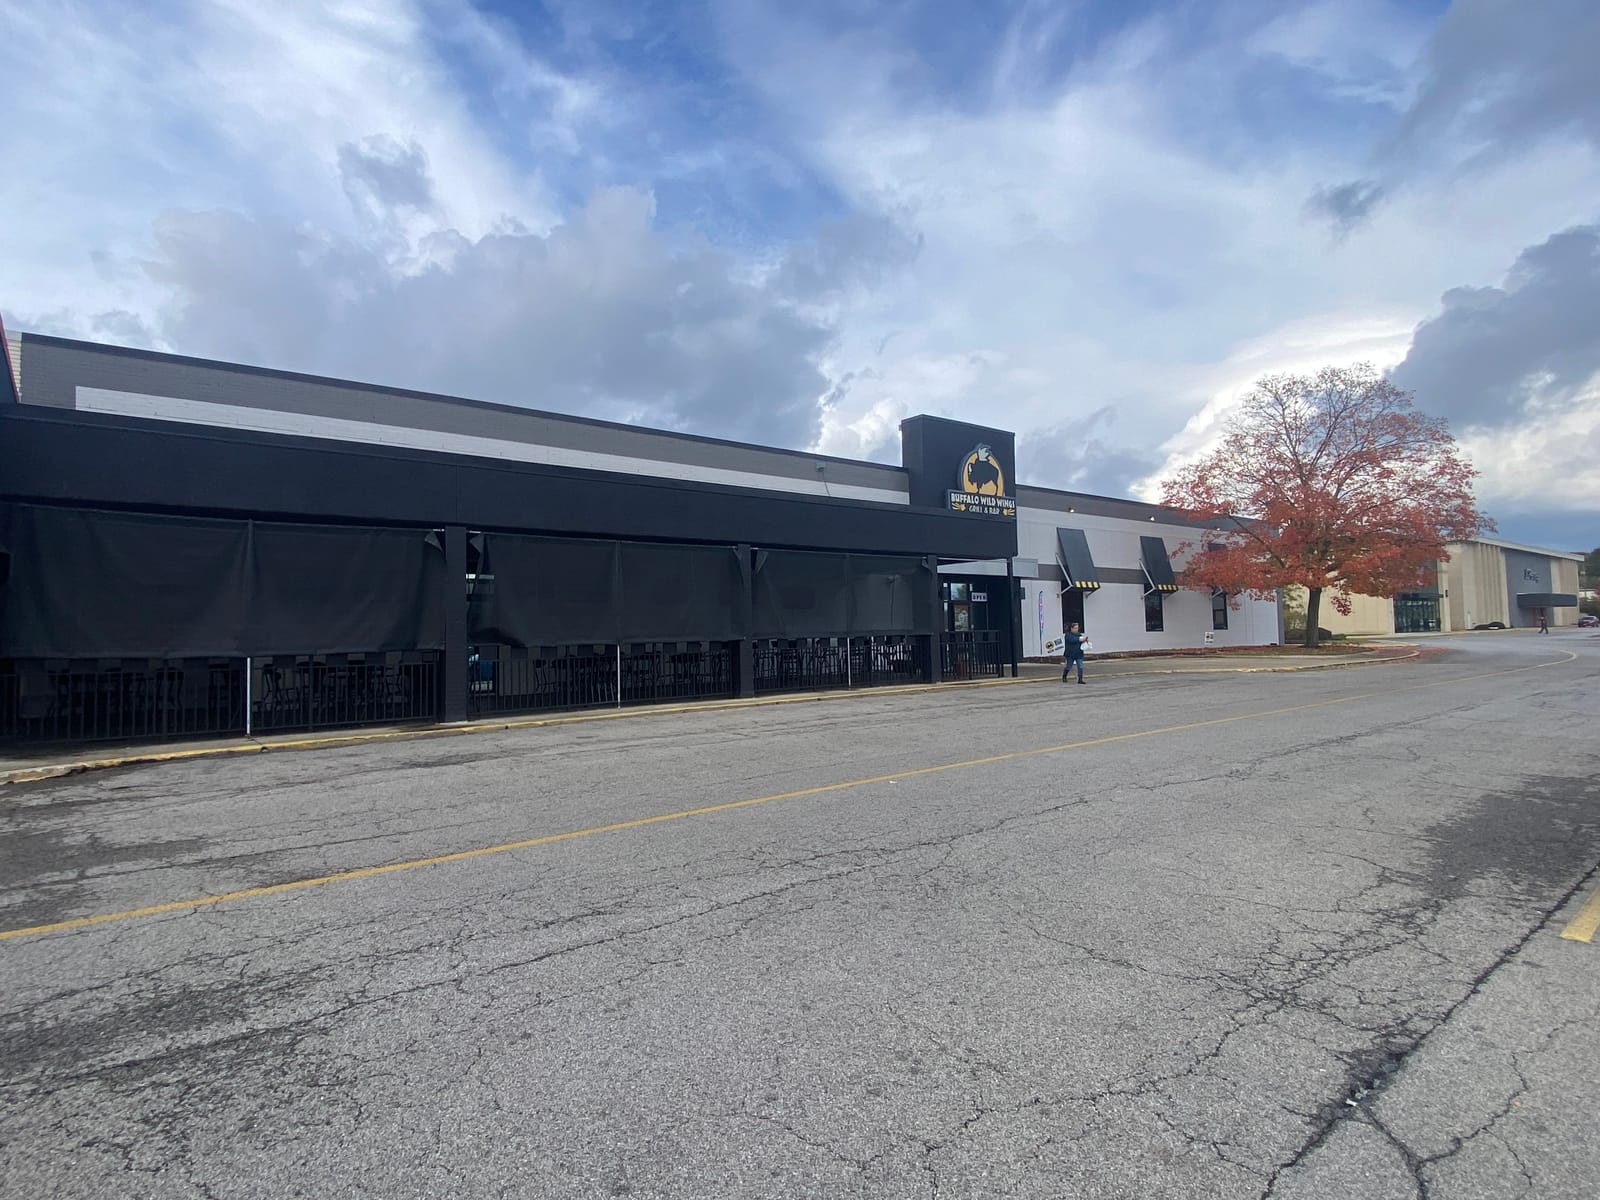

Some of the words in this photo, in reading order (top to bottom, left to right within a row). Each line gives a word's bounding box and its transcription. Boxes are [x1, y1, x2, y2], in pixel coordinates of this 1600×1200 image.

[951, 493, 979, 504] BUFFALO
[981, 496, 996, 506] WILD
[997, 498, 1015, 508] WINGS
